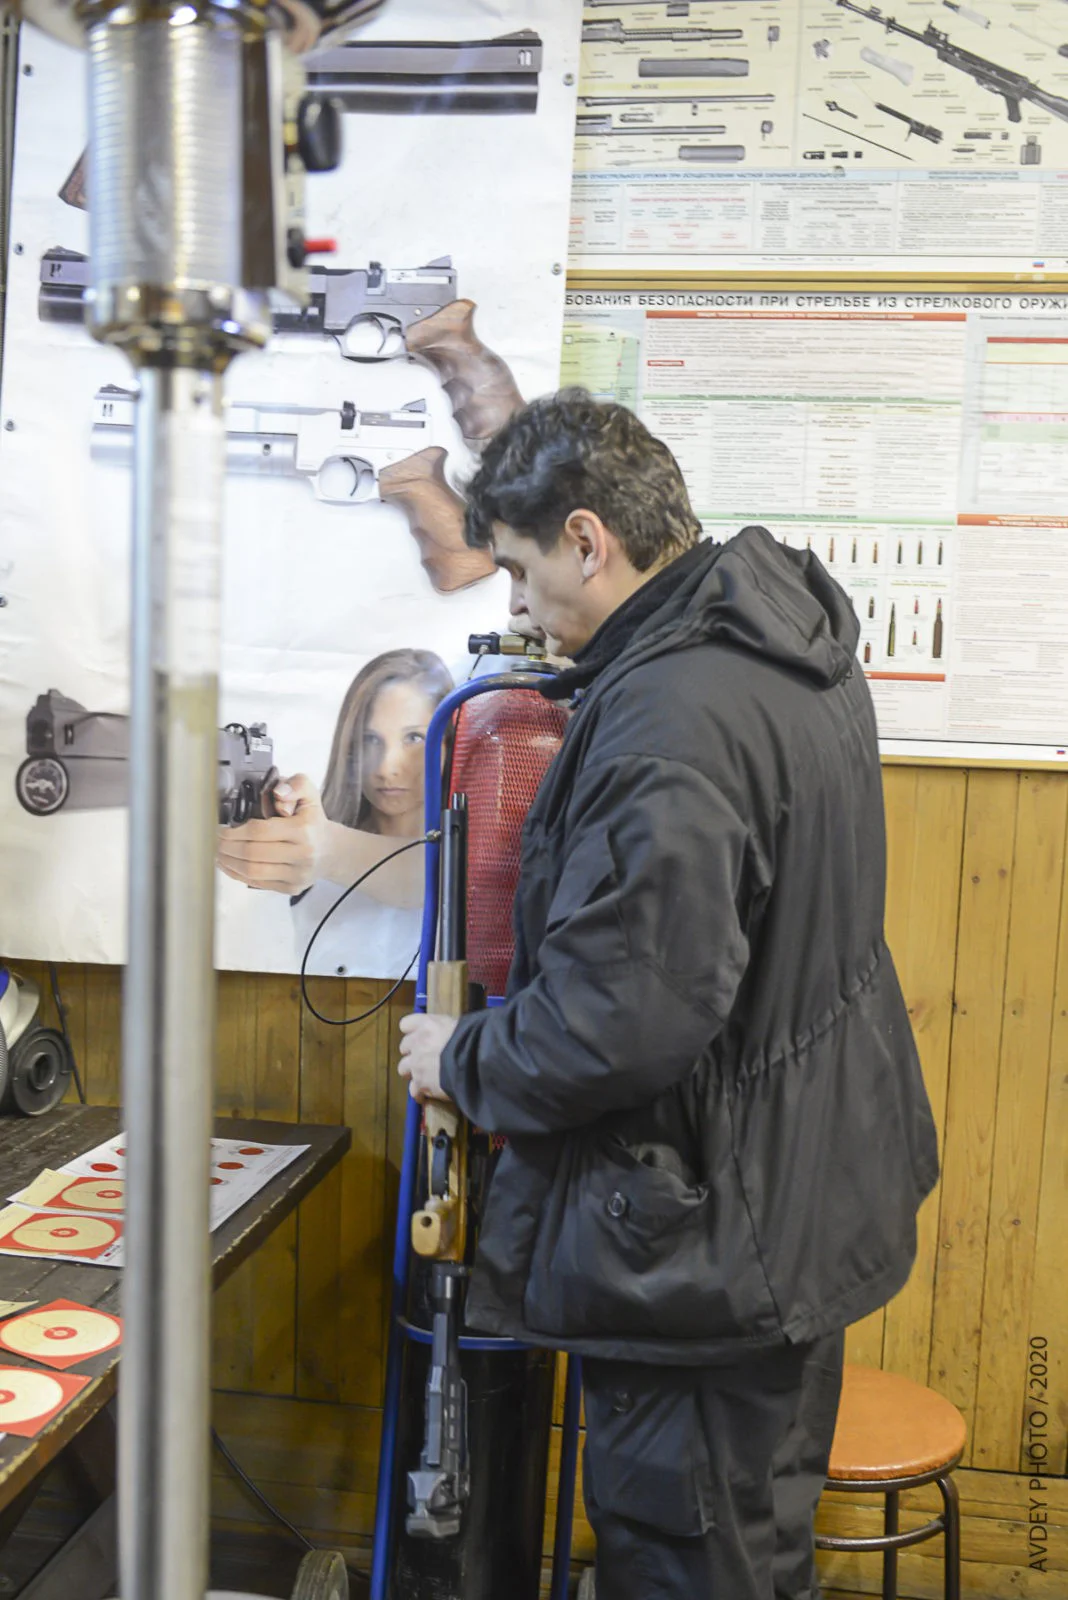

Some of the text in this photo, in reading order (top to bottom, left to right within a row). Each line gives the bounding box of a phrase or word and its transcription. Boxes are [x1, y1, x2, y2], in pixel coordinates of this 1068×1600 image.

[638, 295, 753, 307] БЕЗОПАСНОСТИ
[759, 296, 789, 307] ПРИ
[796, 296, 871, 308] СТРЕЛЬБЕ
[878, 297, 897, 308] ИЗ
[904, 297, 1012, 309] СТРЕЛКОВОГО
